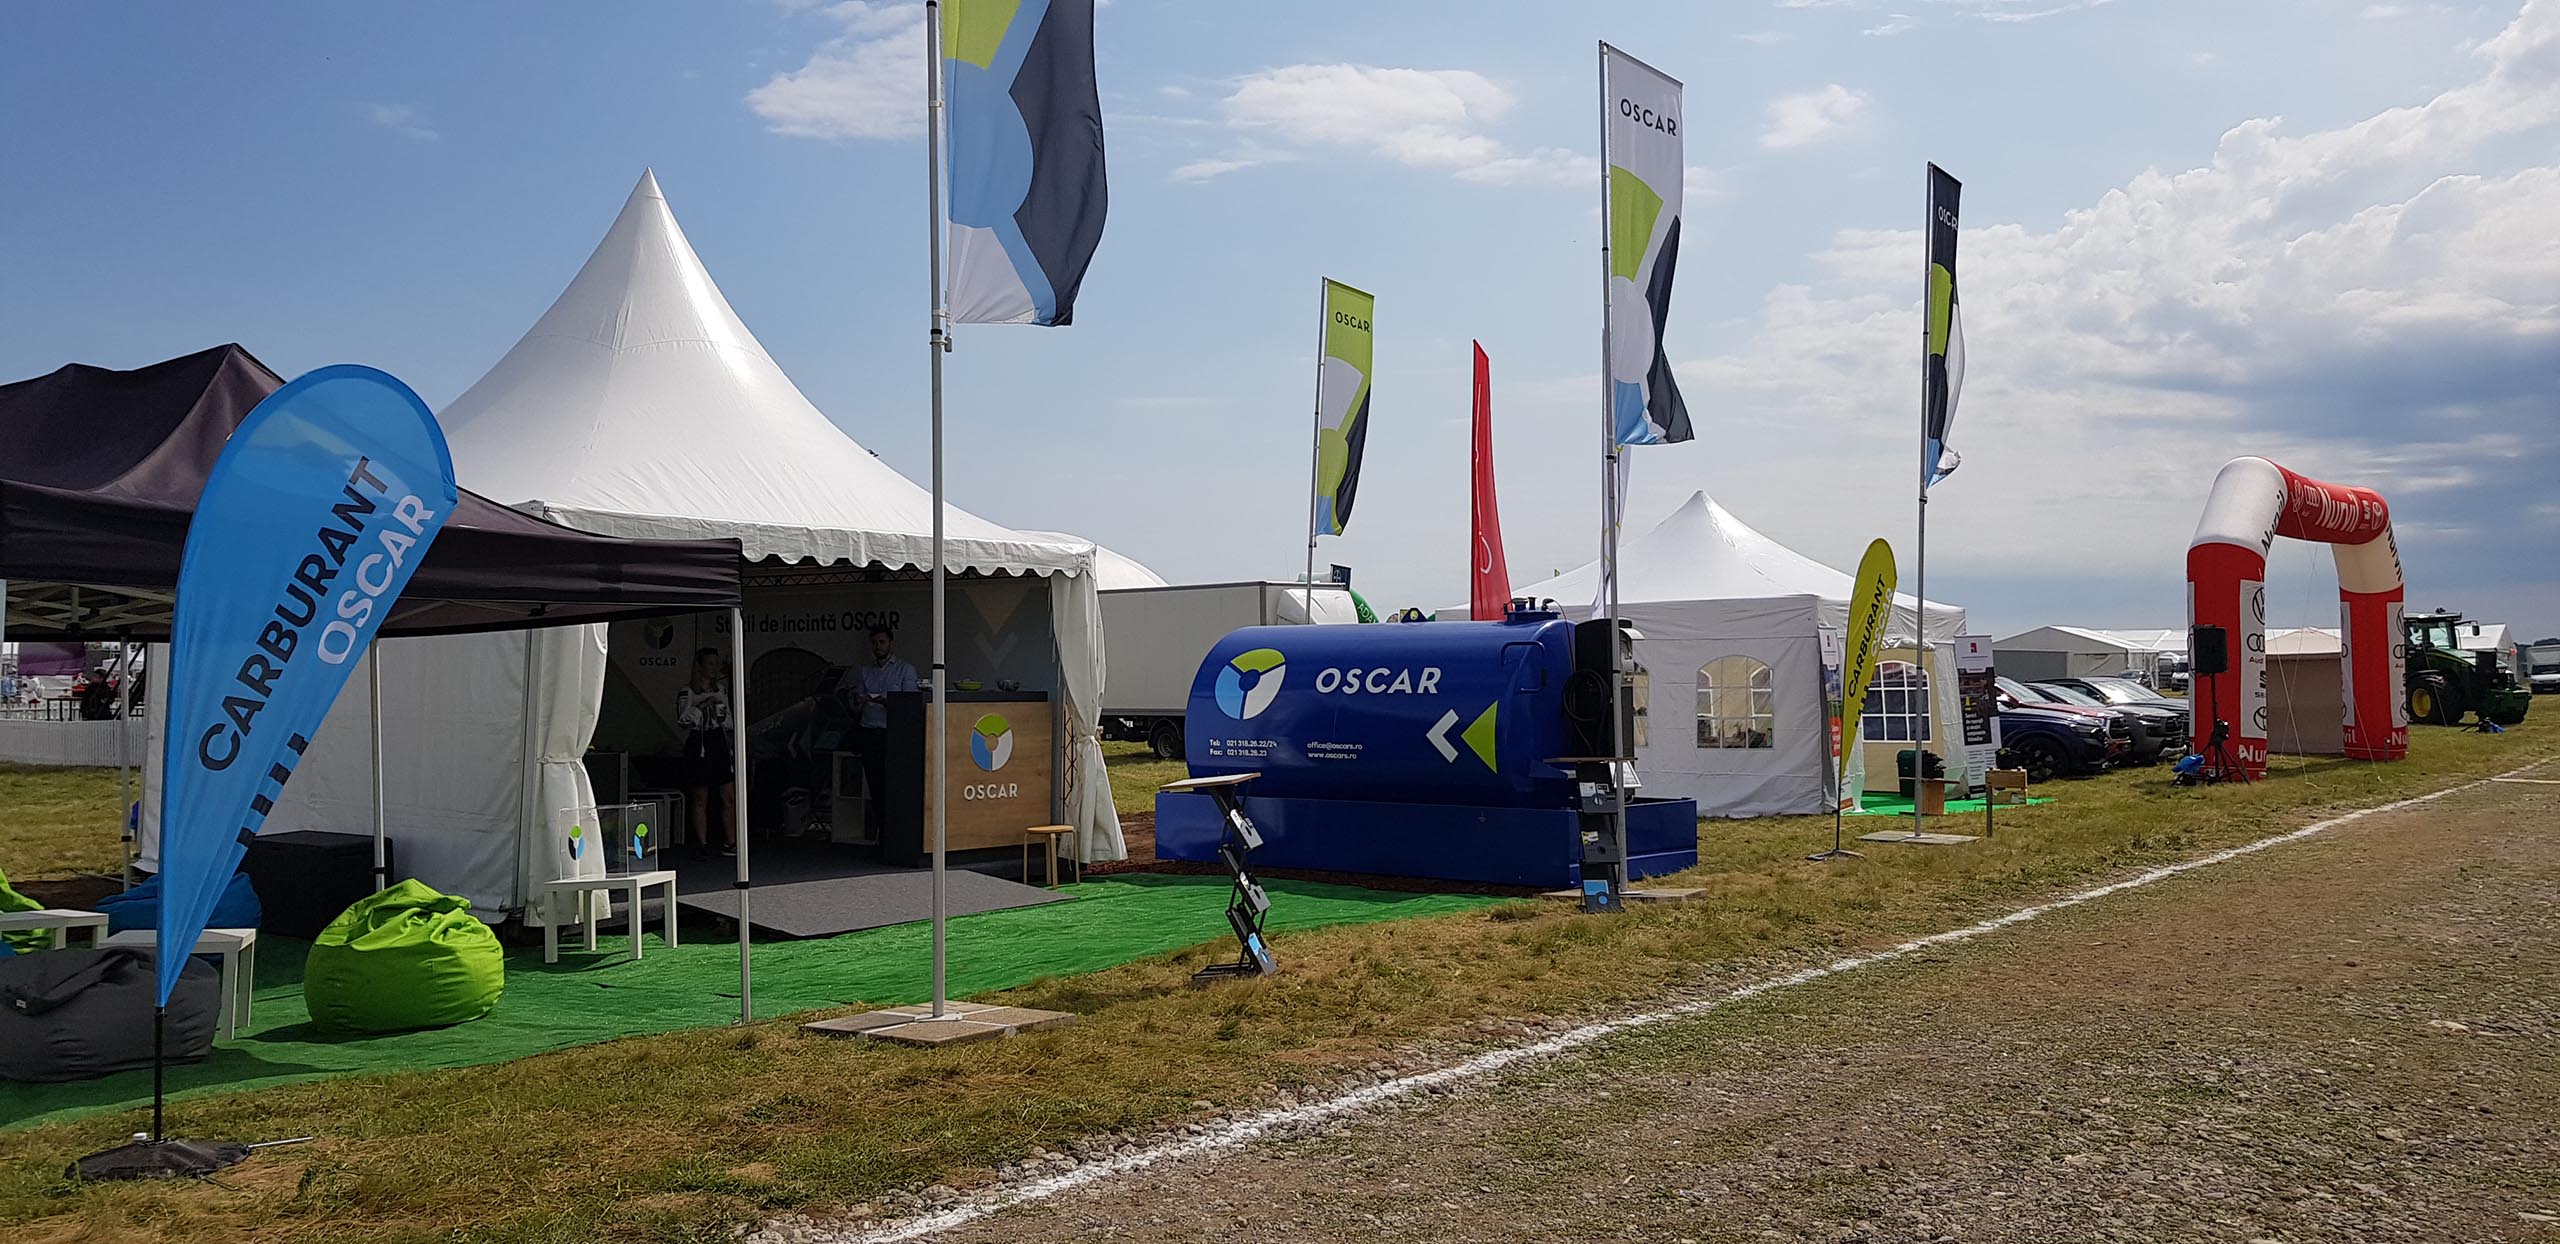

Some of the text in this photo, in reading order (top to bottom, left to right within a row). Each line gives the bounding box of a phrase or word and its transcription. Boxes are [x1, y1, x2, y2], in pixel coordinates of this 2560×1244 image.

[1620, 98, 1677, 137] OSCAR
[1938, 205, 1958, 231] OCR
[1335, 311, 1370, 333] OSCAR
[317, 494, 436, 665] OSCAR
[198, 455, 389, 772] CARBURANT
[759, 615, 778, 633] de
[841, 611, 900, 631] OSCAR
[1848, 573, 1886, 698] CARBURANT
[639, 657, 678, 667] OSCAR
[1315, 667, 1442, 694] OSCAR
[1226, 739, 1238, 747] 021
[1226, 749, 1238, 757] 021
[963, 783, 1018, 801] OSCAR
